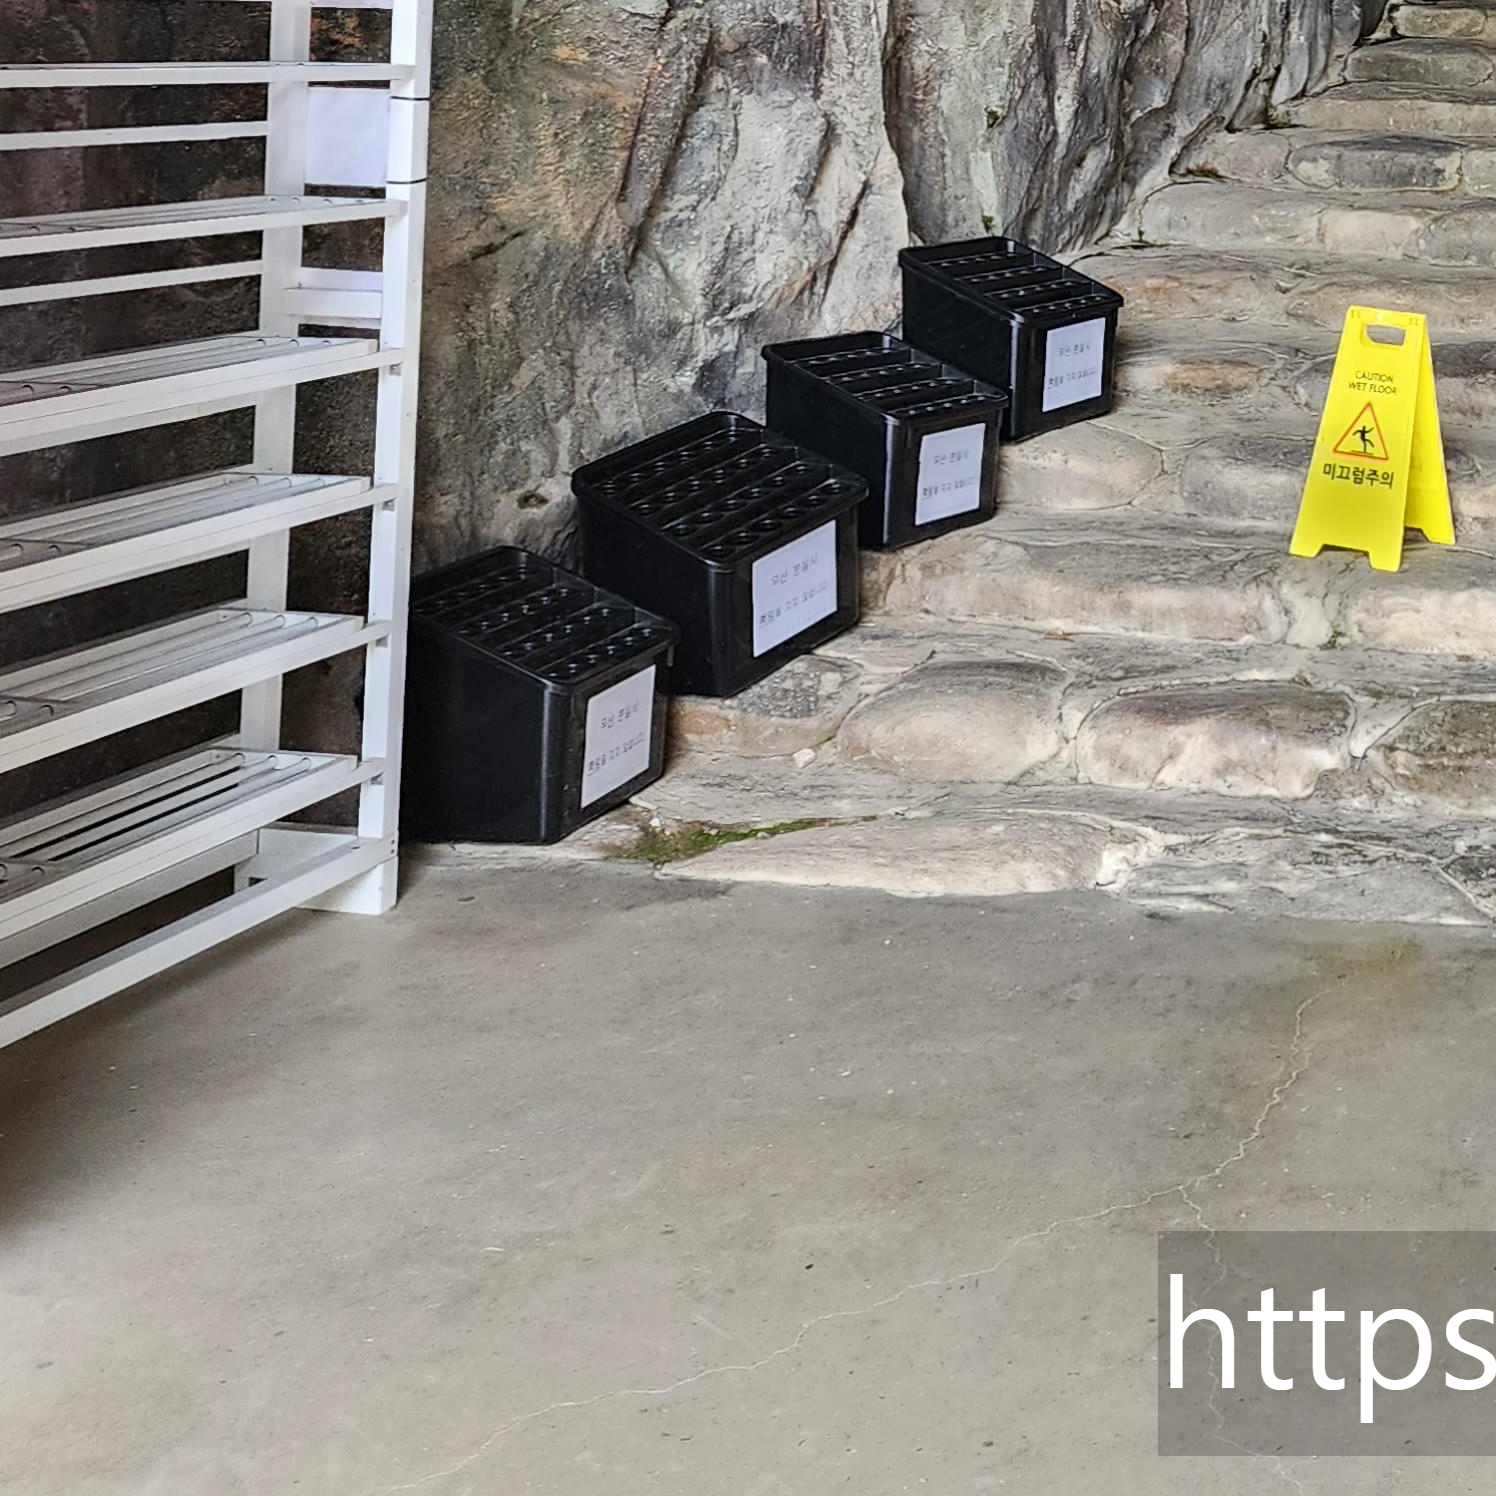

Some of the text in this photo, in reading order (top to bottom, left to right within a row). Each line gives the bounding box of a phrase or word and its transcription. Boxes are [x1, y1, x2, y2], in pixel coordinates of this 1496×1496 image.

[1355, 370, 1394, 384] CAUTION
[1348, 381, 1397, 395] WET FLOOR
[1323, 463, 1394, 490] 미끄럼주의
